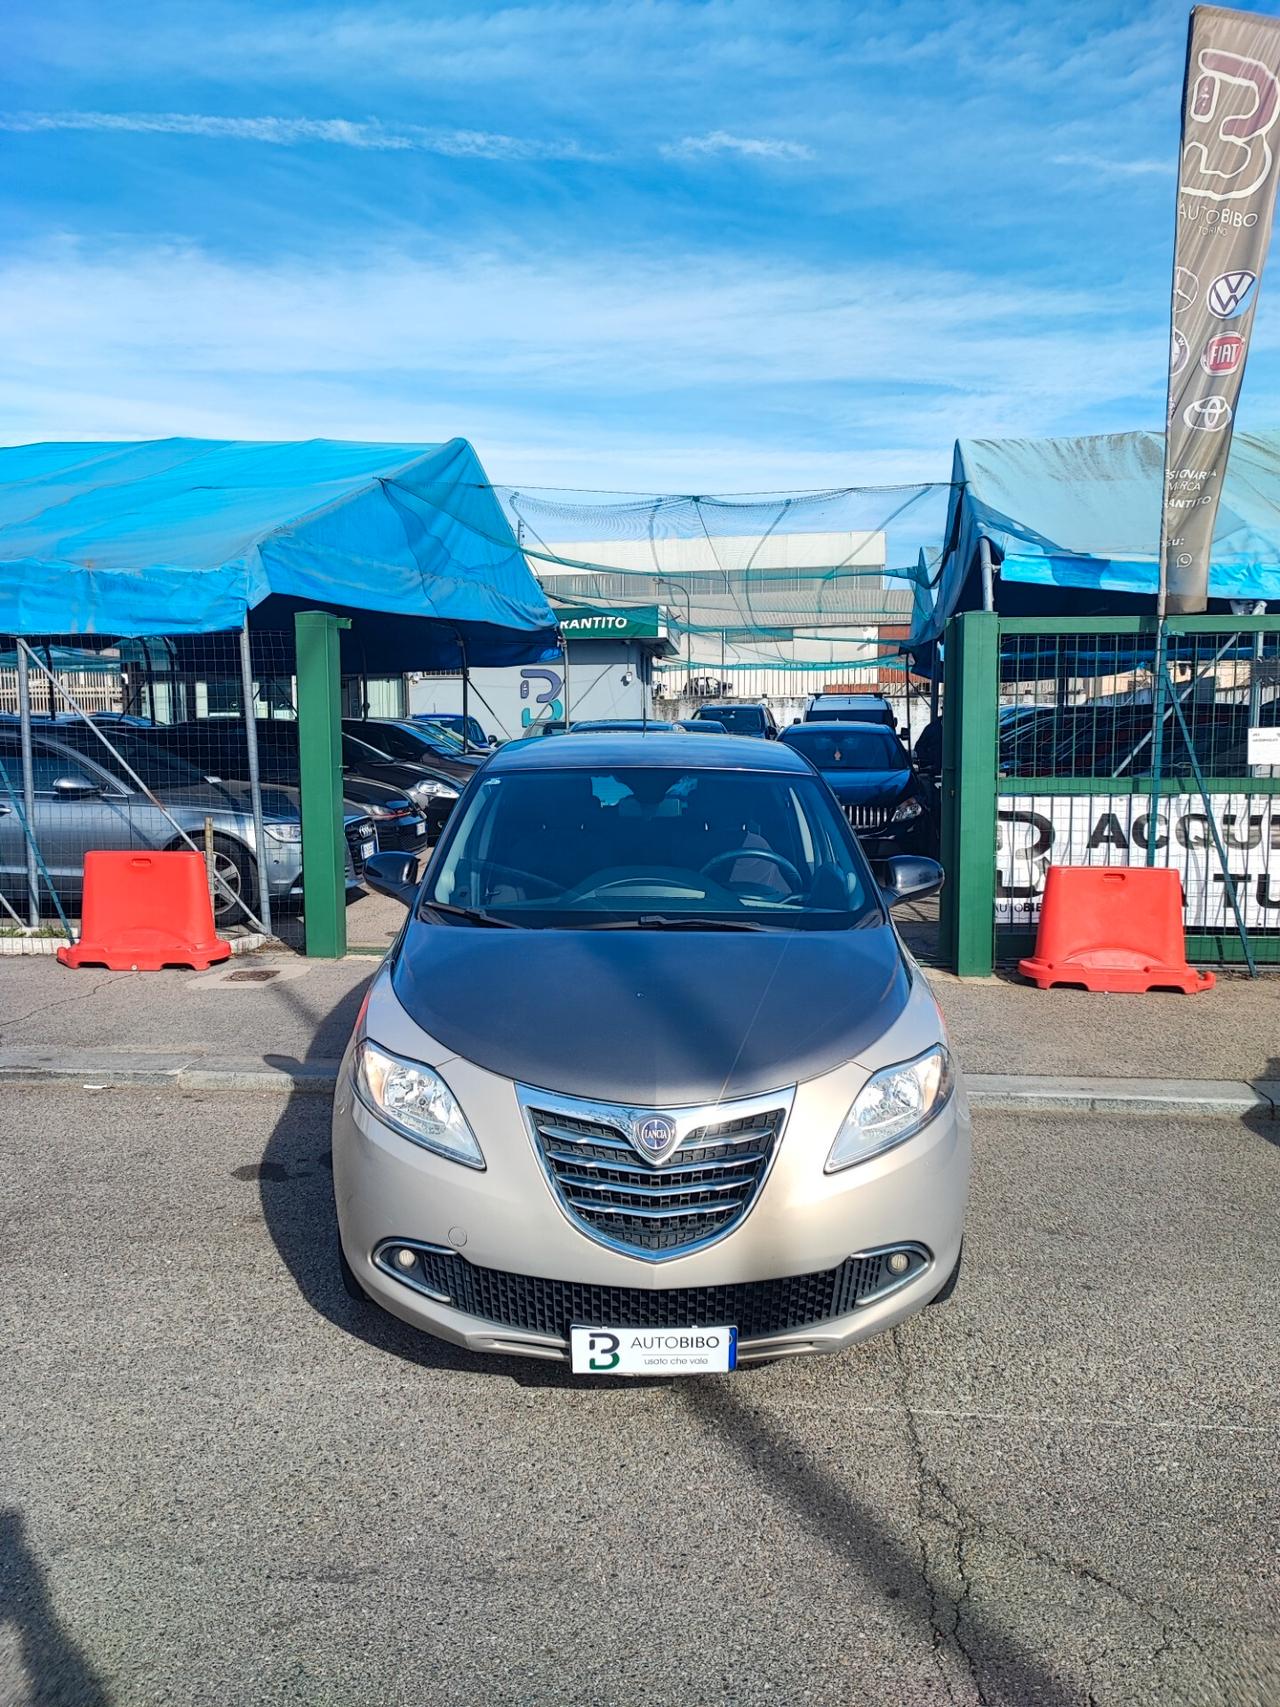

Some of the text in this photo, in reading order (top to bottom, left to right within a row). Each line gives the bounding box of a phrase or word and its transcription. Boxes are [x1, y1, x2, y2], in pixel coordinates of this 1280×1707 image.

[1179, 203, 1258, 228] AUTOBIBO
[1210, 343, 1239, 365] FIAT
[645, 1129, 667, 1139] LANCIA
[630, 1336, 720, 1349] AUTOBIBO
[644, 1357, 709, 1366] usato che vale
